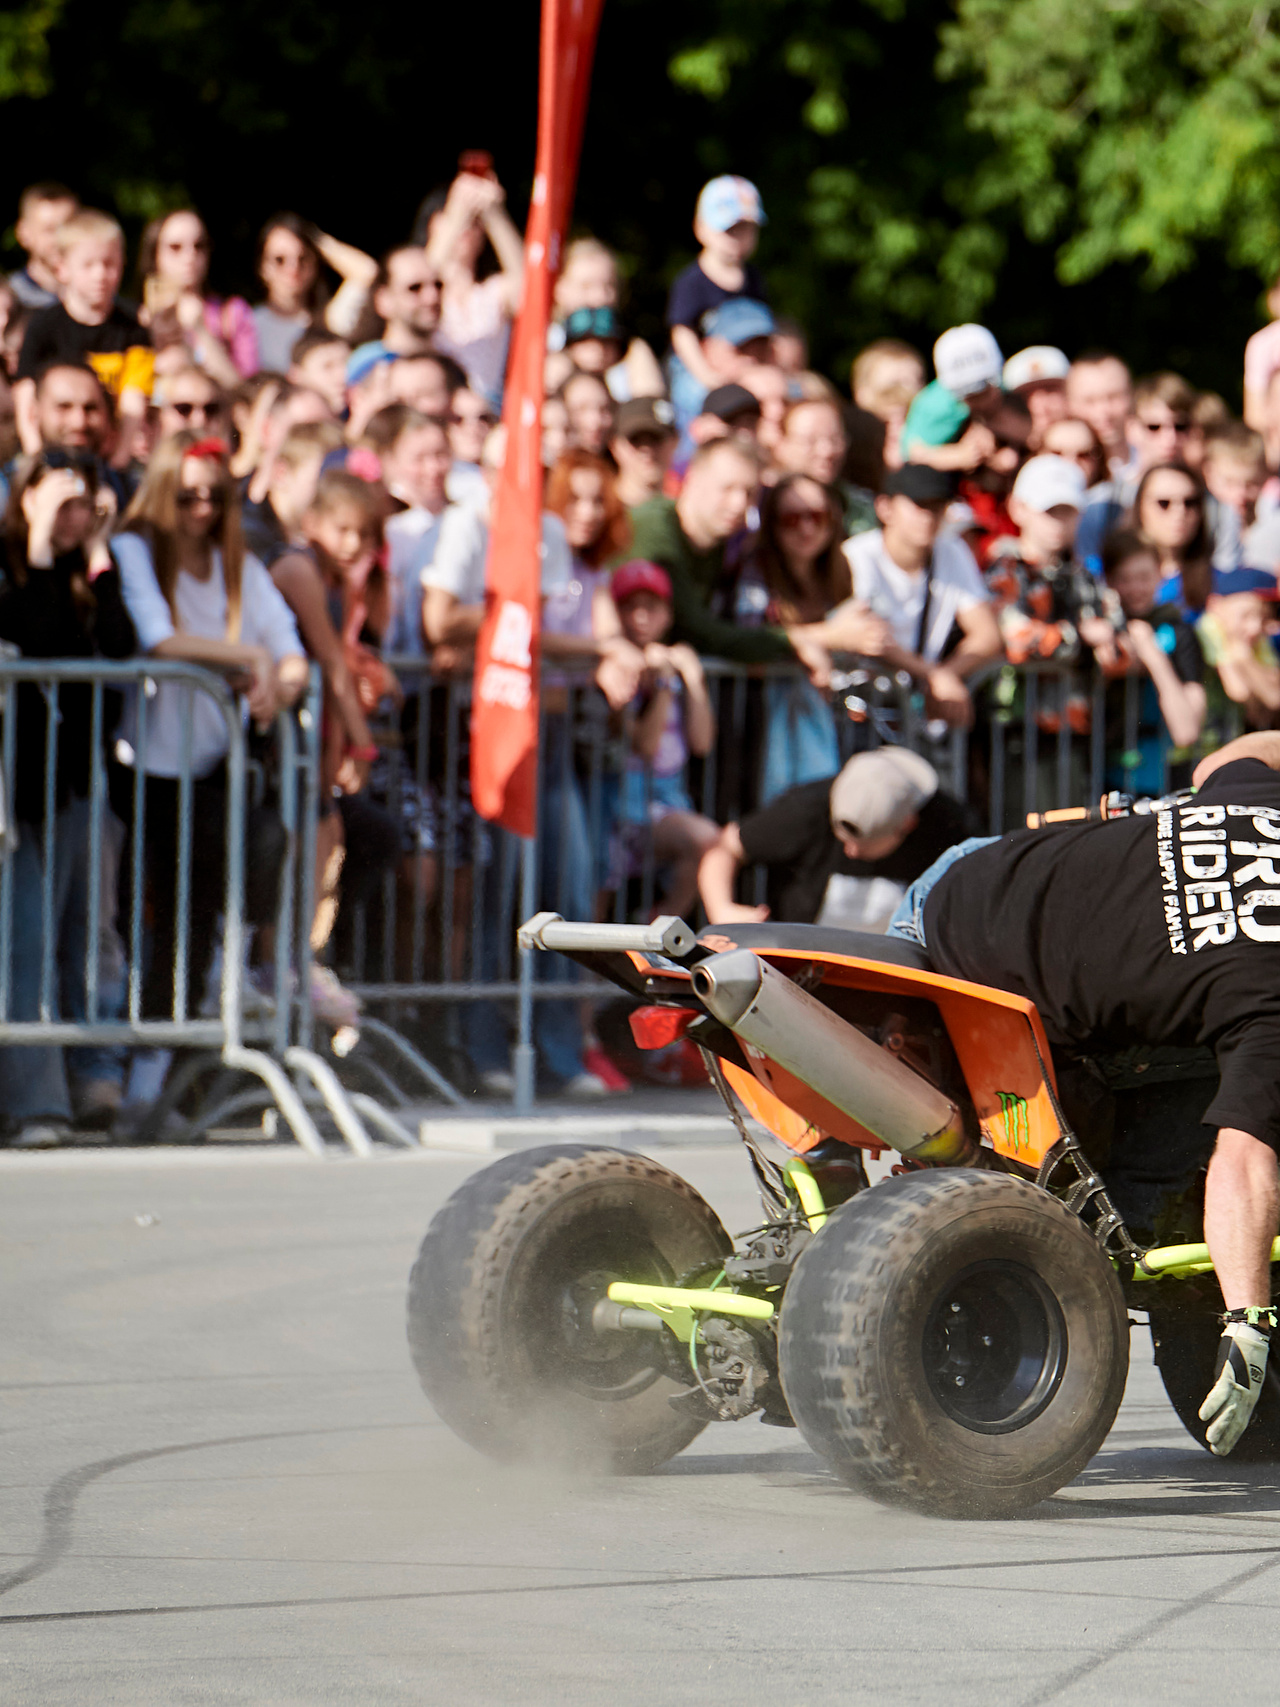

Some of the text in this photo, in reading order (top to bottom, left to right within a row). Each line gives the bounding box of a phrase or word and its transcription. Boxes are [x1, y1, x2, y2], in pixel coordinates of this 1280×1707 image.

[1157, 810, 1188, 955] HUGE HAPPY FAMILY
[1179, 805, 1238, 952] RIDER
